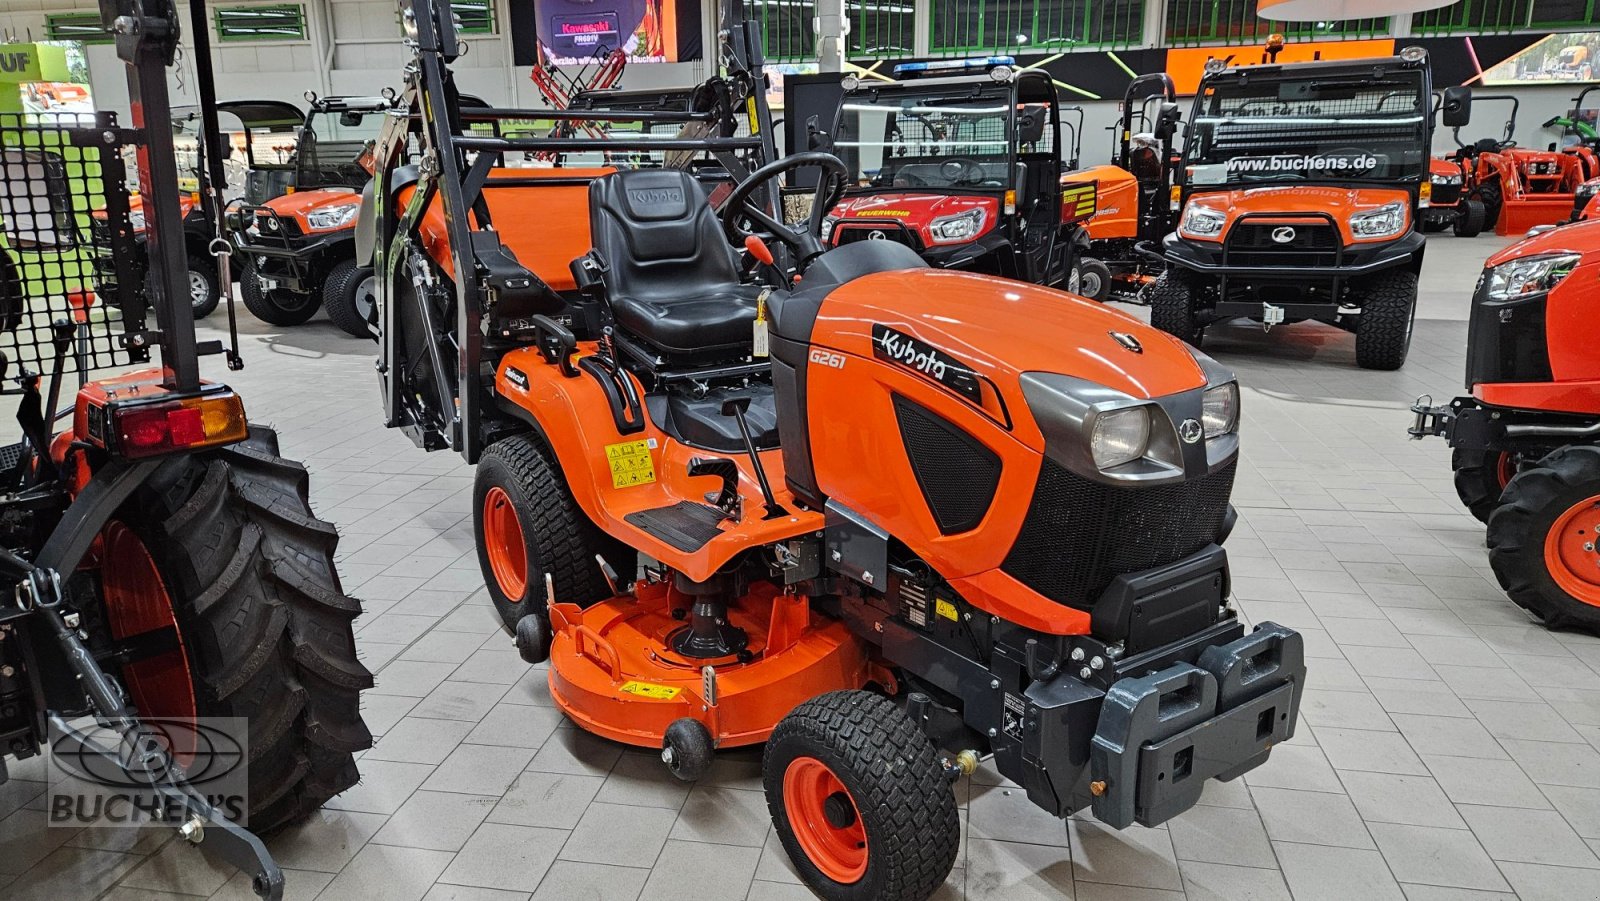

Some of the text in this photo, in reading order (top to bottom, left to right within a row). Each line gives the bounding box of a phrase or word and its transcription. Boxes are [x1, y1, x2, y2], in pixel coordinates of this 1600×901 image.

[562, 21, 609, 33] Kawasaki
[1224, 154, 1377, 171] www.buchens.de
[631, 189, 680, 203] Kubota
[856, 209, 911, 217] FEUERWEHR
[809, 350, 847, 370] G261
[881, 329, 946, 380] Kubota
